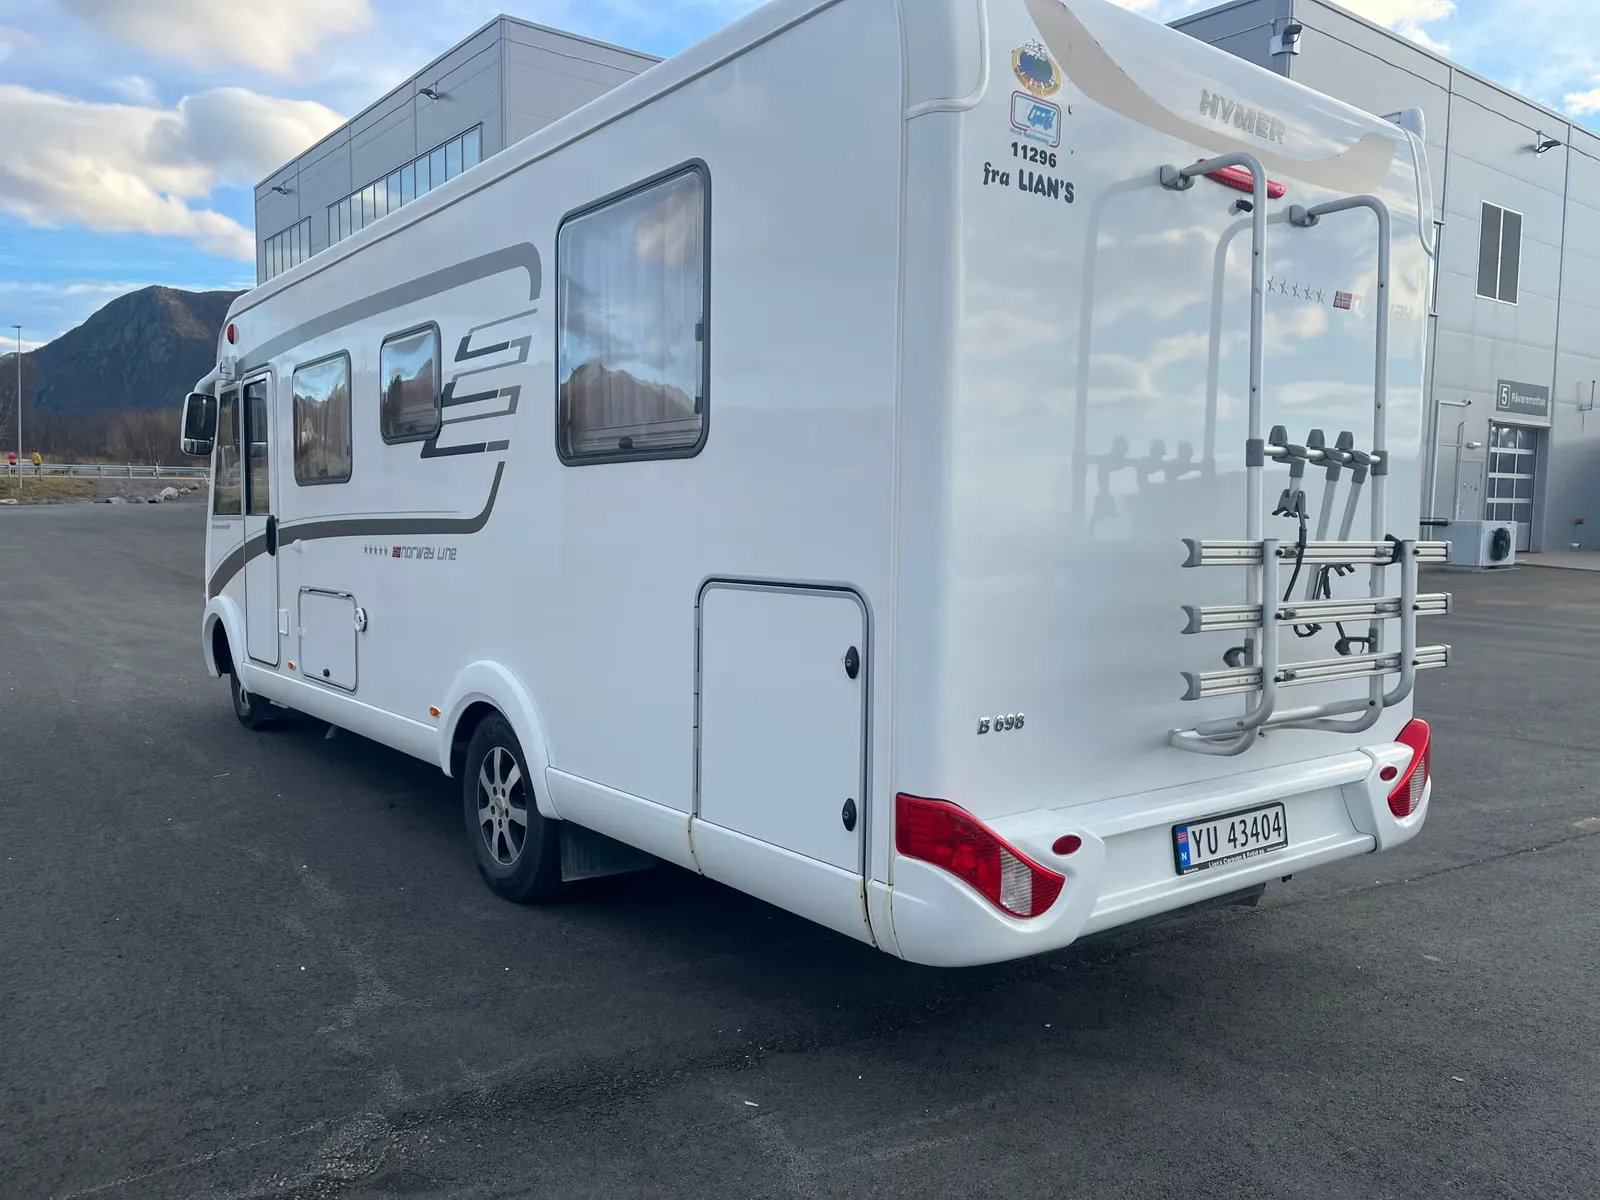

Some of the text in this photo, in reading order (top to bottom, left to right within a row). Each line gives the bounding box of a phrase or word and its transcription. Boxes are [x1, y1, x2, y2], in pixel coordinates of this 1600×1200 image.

[1199, 89, 1286, 145] HYMER
[1011, 141, 1057, 168] 11296
[983, 161, 1075, 204] fra LIAN'S
[1501, 387, 1508, 405] 5
[977, 712, 1025, 735] B 698
[1191, 811, 1282, 858] YU 43404
[1181, 851, 1188, 861] N
